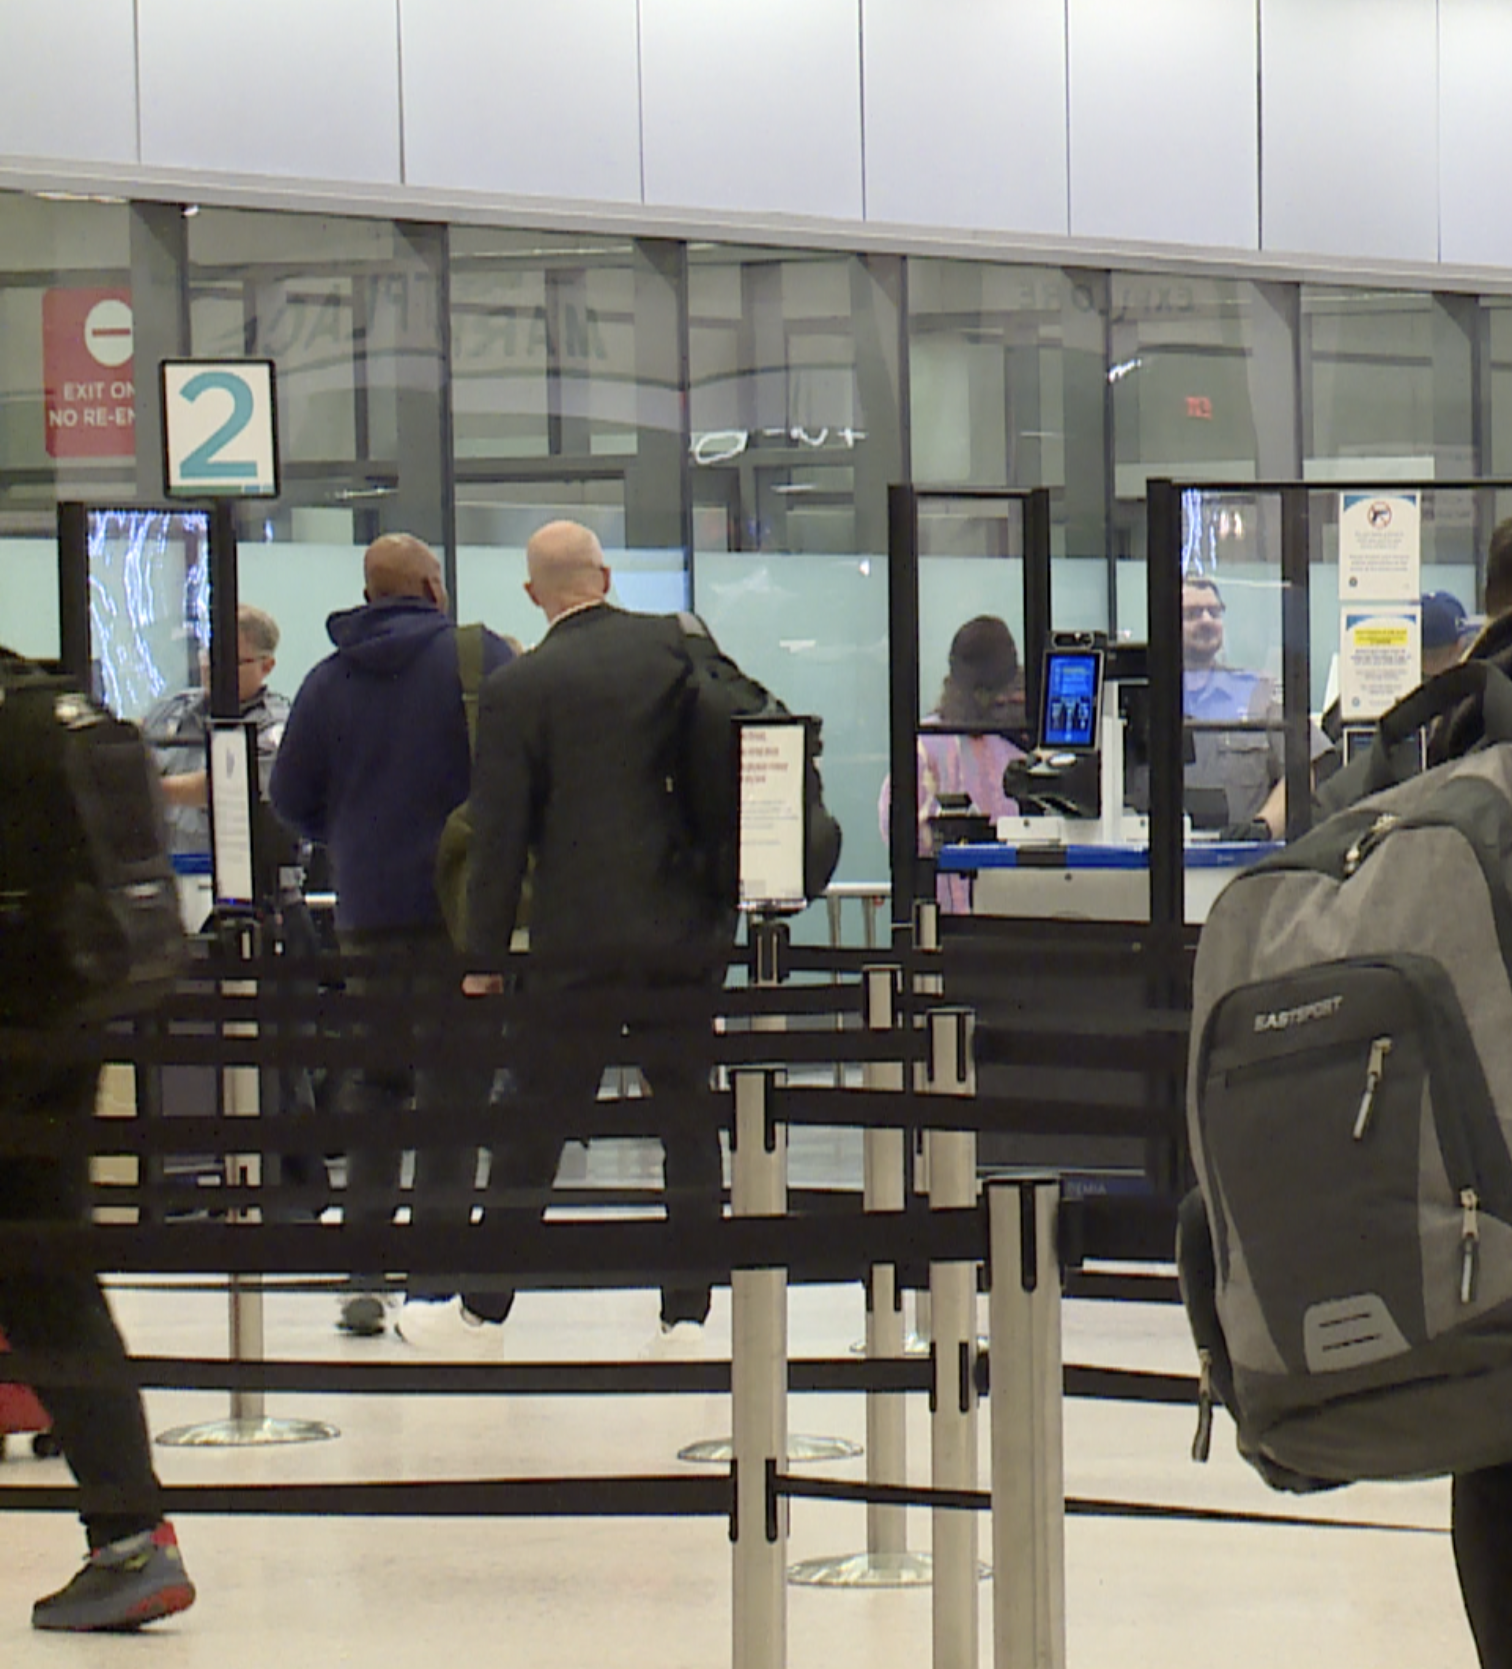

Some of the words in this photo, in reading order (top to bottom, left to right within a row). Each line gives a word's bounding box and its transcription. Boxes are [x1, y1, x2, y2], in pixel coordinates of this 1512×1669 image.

[63, 382, 104, 400] EXIT
[110, 382, 136, 399] ON
[49, 409, 78, 427] NO
[83, 407, 136, 426] RE-EN
[179, 371, 258, 480] 2
[1254, 995, 1343, 1032] EASTSPORT
